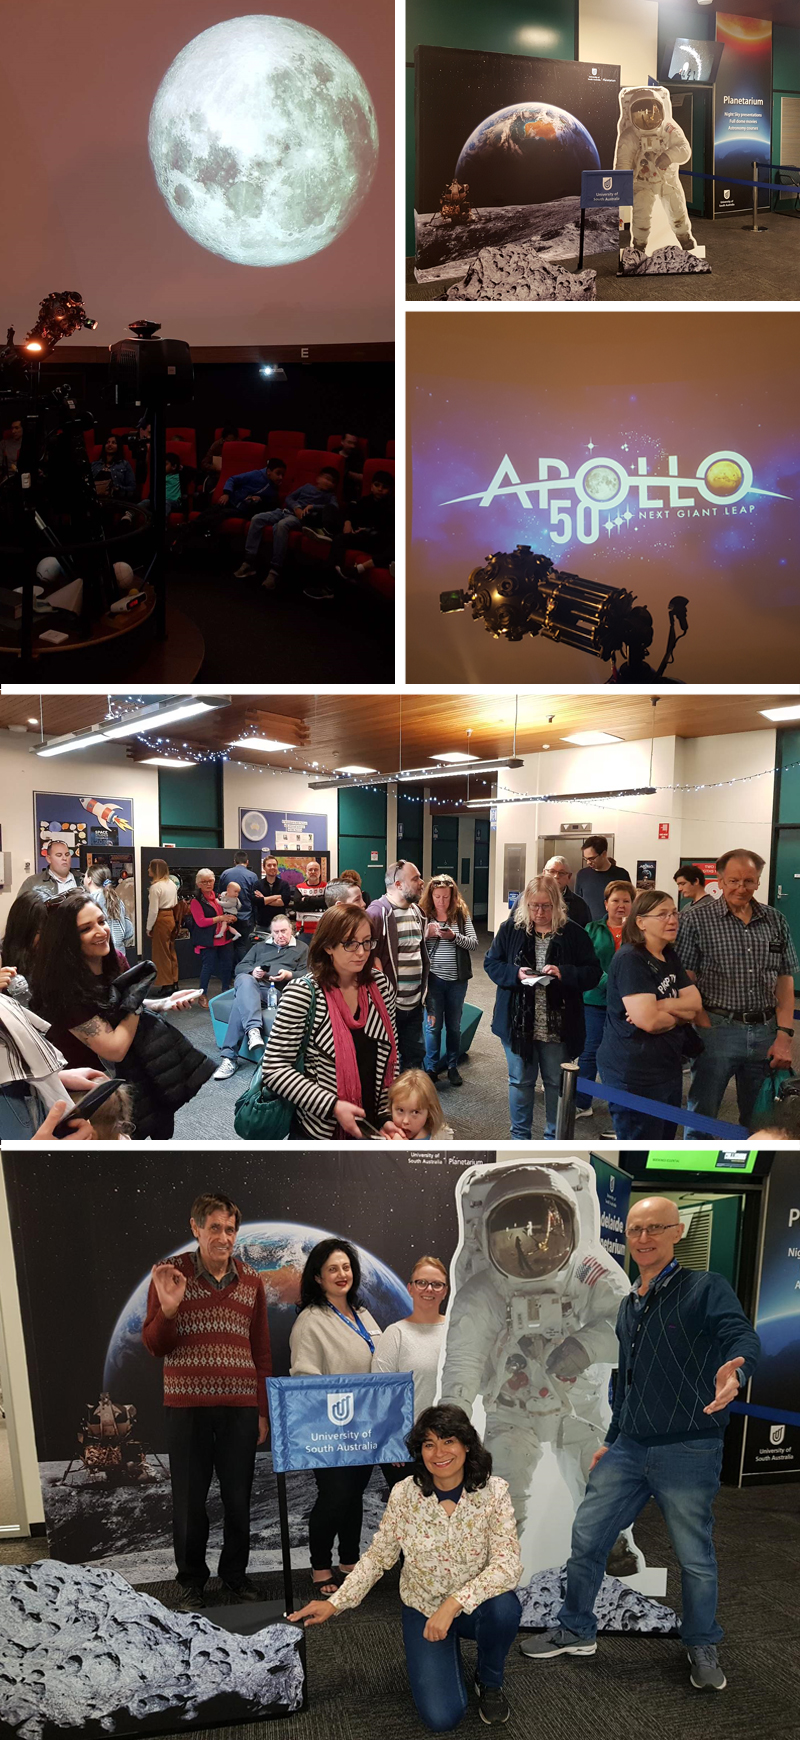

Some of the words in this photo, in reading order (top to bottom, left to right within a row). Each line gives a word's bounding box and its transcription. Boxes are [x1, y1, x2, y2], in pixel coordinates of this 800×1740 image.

[723, 95, 764, 106] Planetarium
[301, 348, 309, 358] E
[479, 450, 753, 510] APOLLO
[638, 511, 670, 519] NEXT
[677, 508, 718, 518] GIANT
[725, 505, 756, 515] LEAP
[550, 500, 600, 544] 50
[601, 1211, 624, 1233] delaide
[311, 1430, 359, 1442] University
[362, 1429, 372, 1438] of
[305, 1444, 334, 1454] South
[337, 1442, 378, 1452] Australia
